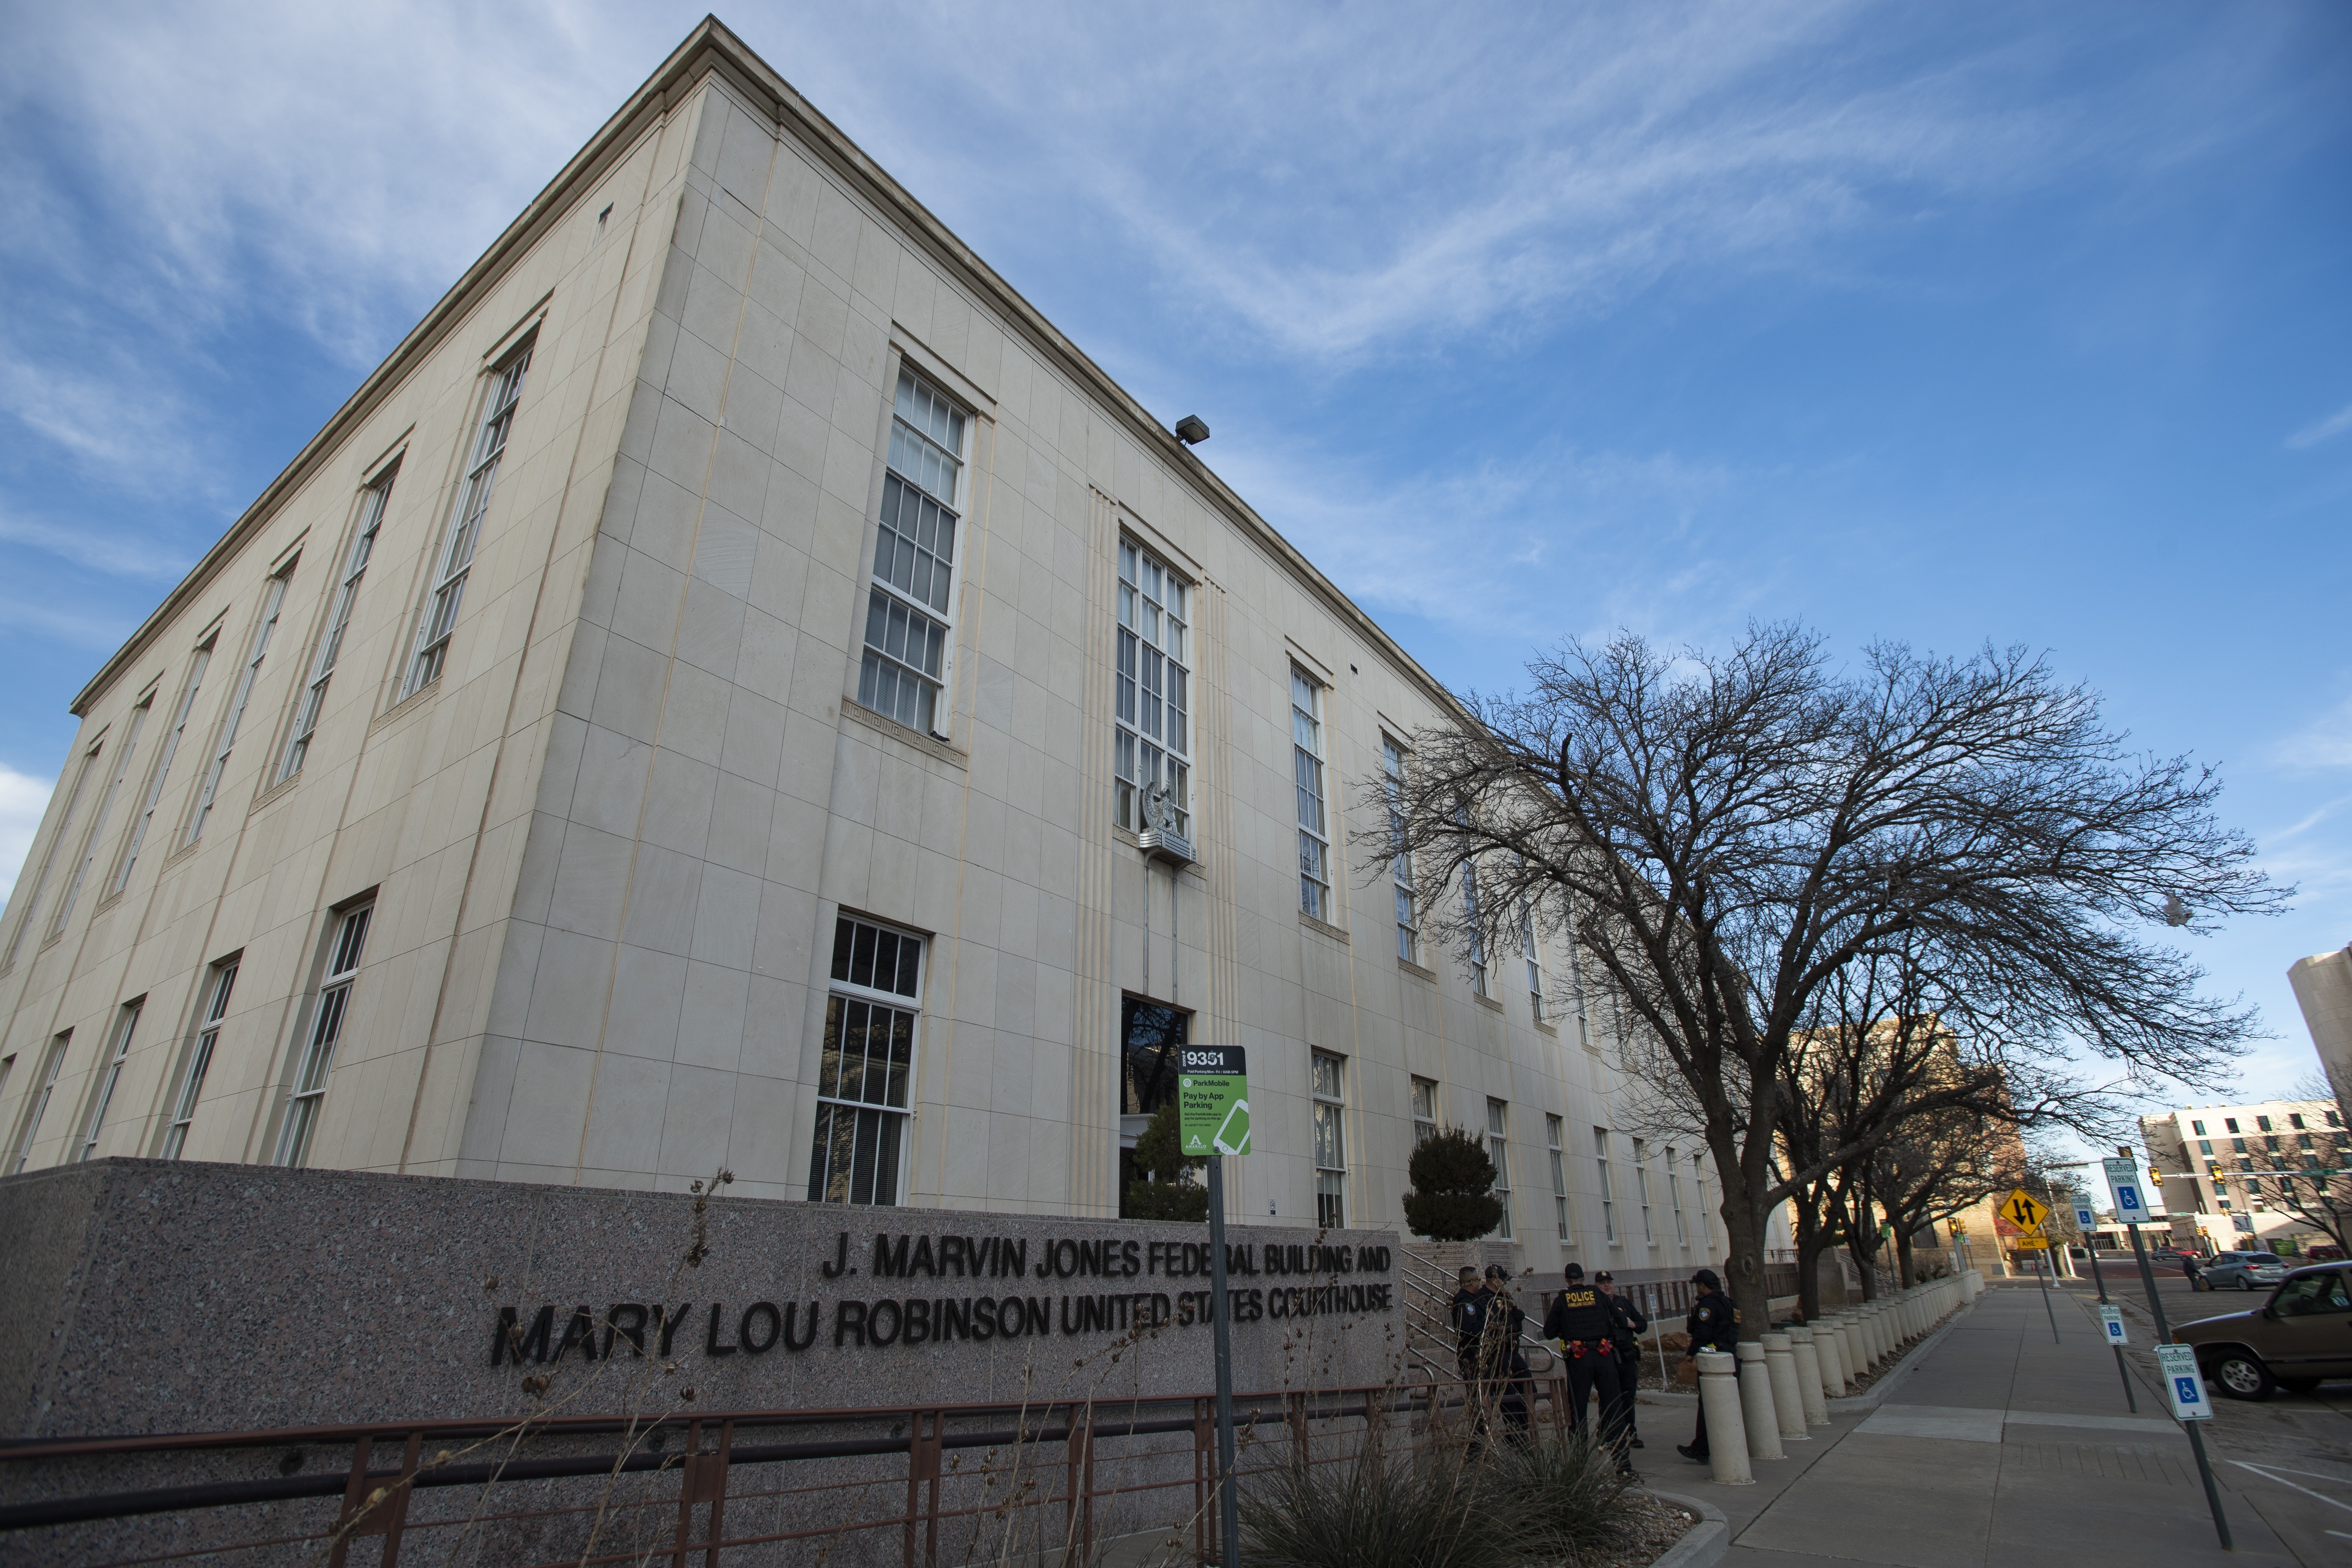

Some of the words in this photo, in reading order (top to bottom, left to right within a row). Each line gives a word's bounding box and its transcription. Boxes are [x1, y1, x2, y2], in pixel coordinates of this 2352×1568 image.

[1187, 1051, 1224, 1066] 9351
[1184, 1092, 1198, 1100] Pay
[1198, 1092, 1207, 1100] by
[1209, 1092, 1224, 1100] App
[1184, 1102, 1212, 1110] Parking
[2105, 1164, 2133, 1172] RESERVED
[2110, 1175, 2135, 1183] PARKING
[823, 1232, 858, 1279] J.
[874, 1233, 1026, 1277] MARVIN
[1037, 1239, 1140, 1277] JONES
[1266, 1244, 1352, 1273] BUILDING
[1357, 1246, 1391, 1273] AND
[1565, 1291, 1595, 1303] POLICE
[491, 1303, 692, 1366] MARY
[707, 1301, 819, 1355] LOU
[835, 1296, 1051, 1347] ROBINSON
[1062, 1292, 1171, 1334] UNITED
[1269, 1283, 1394, 1319] COURTHOUSE
[2161, 1352, 2192, 1362] RESERVED
[2166, 1364, 2195, 1374] PARKING
